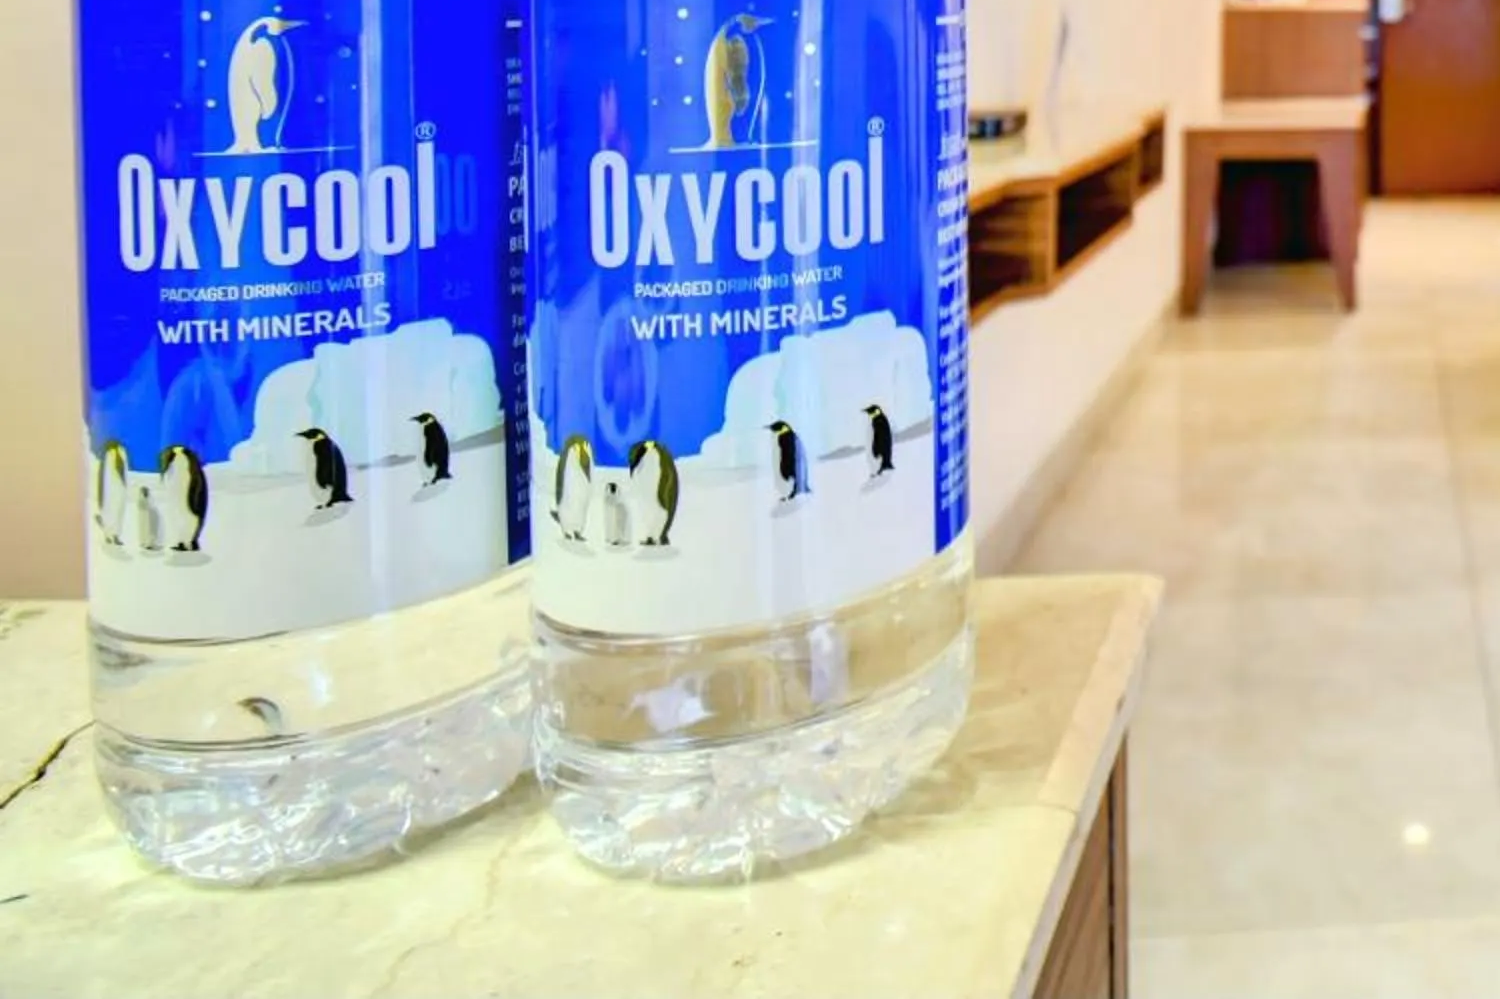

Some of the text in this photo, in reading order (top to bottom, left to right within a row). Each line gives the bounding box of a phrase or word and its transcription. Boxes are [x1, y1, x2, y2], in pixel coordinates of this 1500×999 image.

[160, 271, 386, 302] PACKAGED DRINKING WATER
[634, 264, 844, 299] PACKAGED DRINKING WATER
[157, 301, 392, 345] WITH MINERALS
[630, 293, 848, 341] WITH MINERALS
